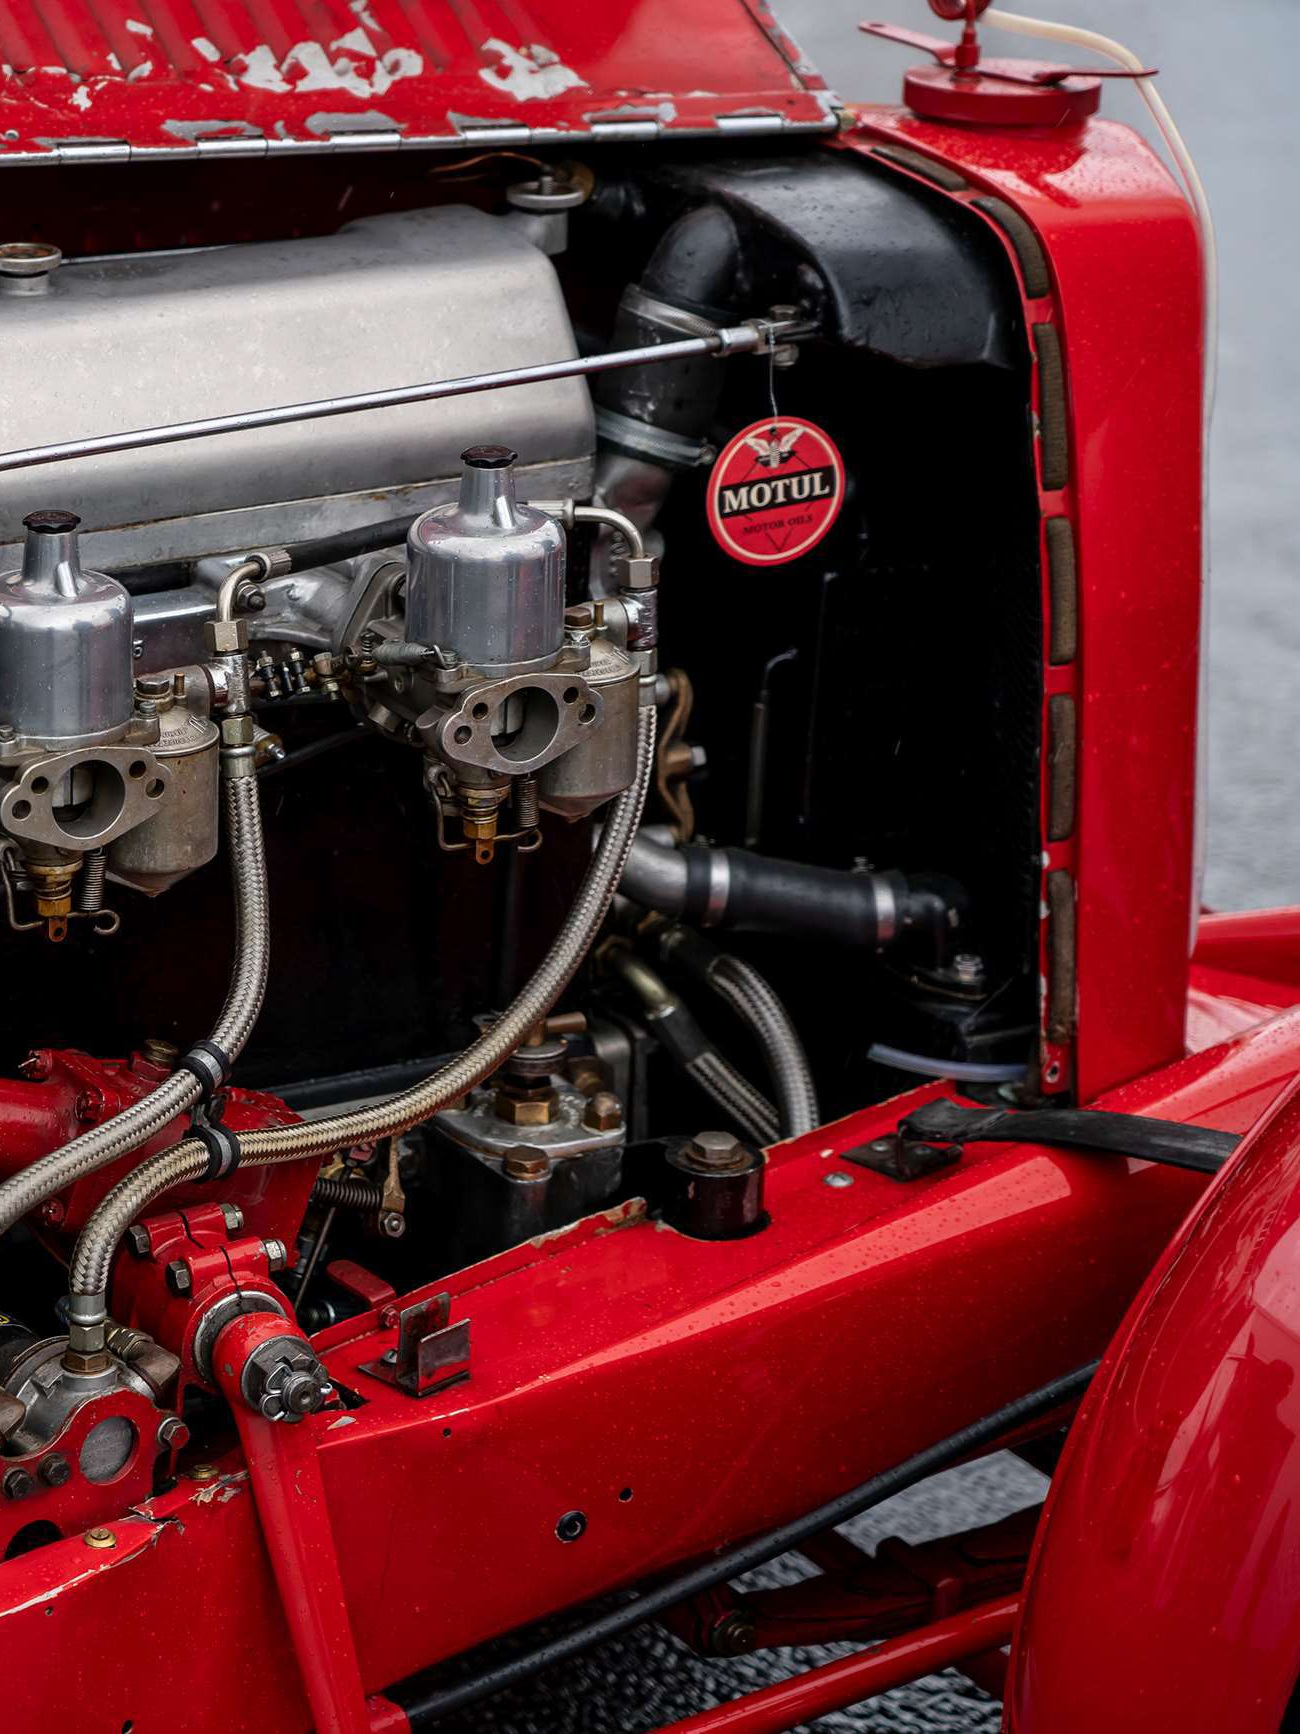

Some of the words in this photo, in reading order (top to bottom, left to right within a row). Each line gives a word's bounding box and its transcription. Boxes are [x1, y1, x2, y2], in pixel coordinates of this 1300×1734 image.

[722, 471, 831, 513] MOTUL
[743, 519, 785, 534] MOTOR
[787, 514, 813, 526] OILS
